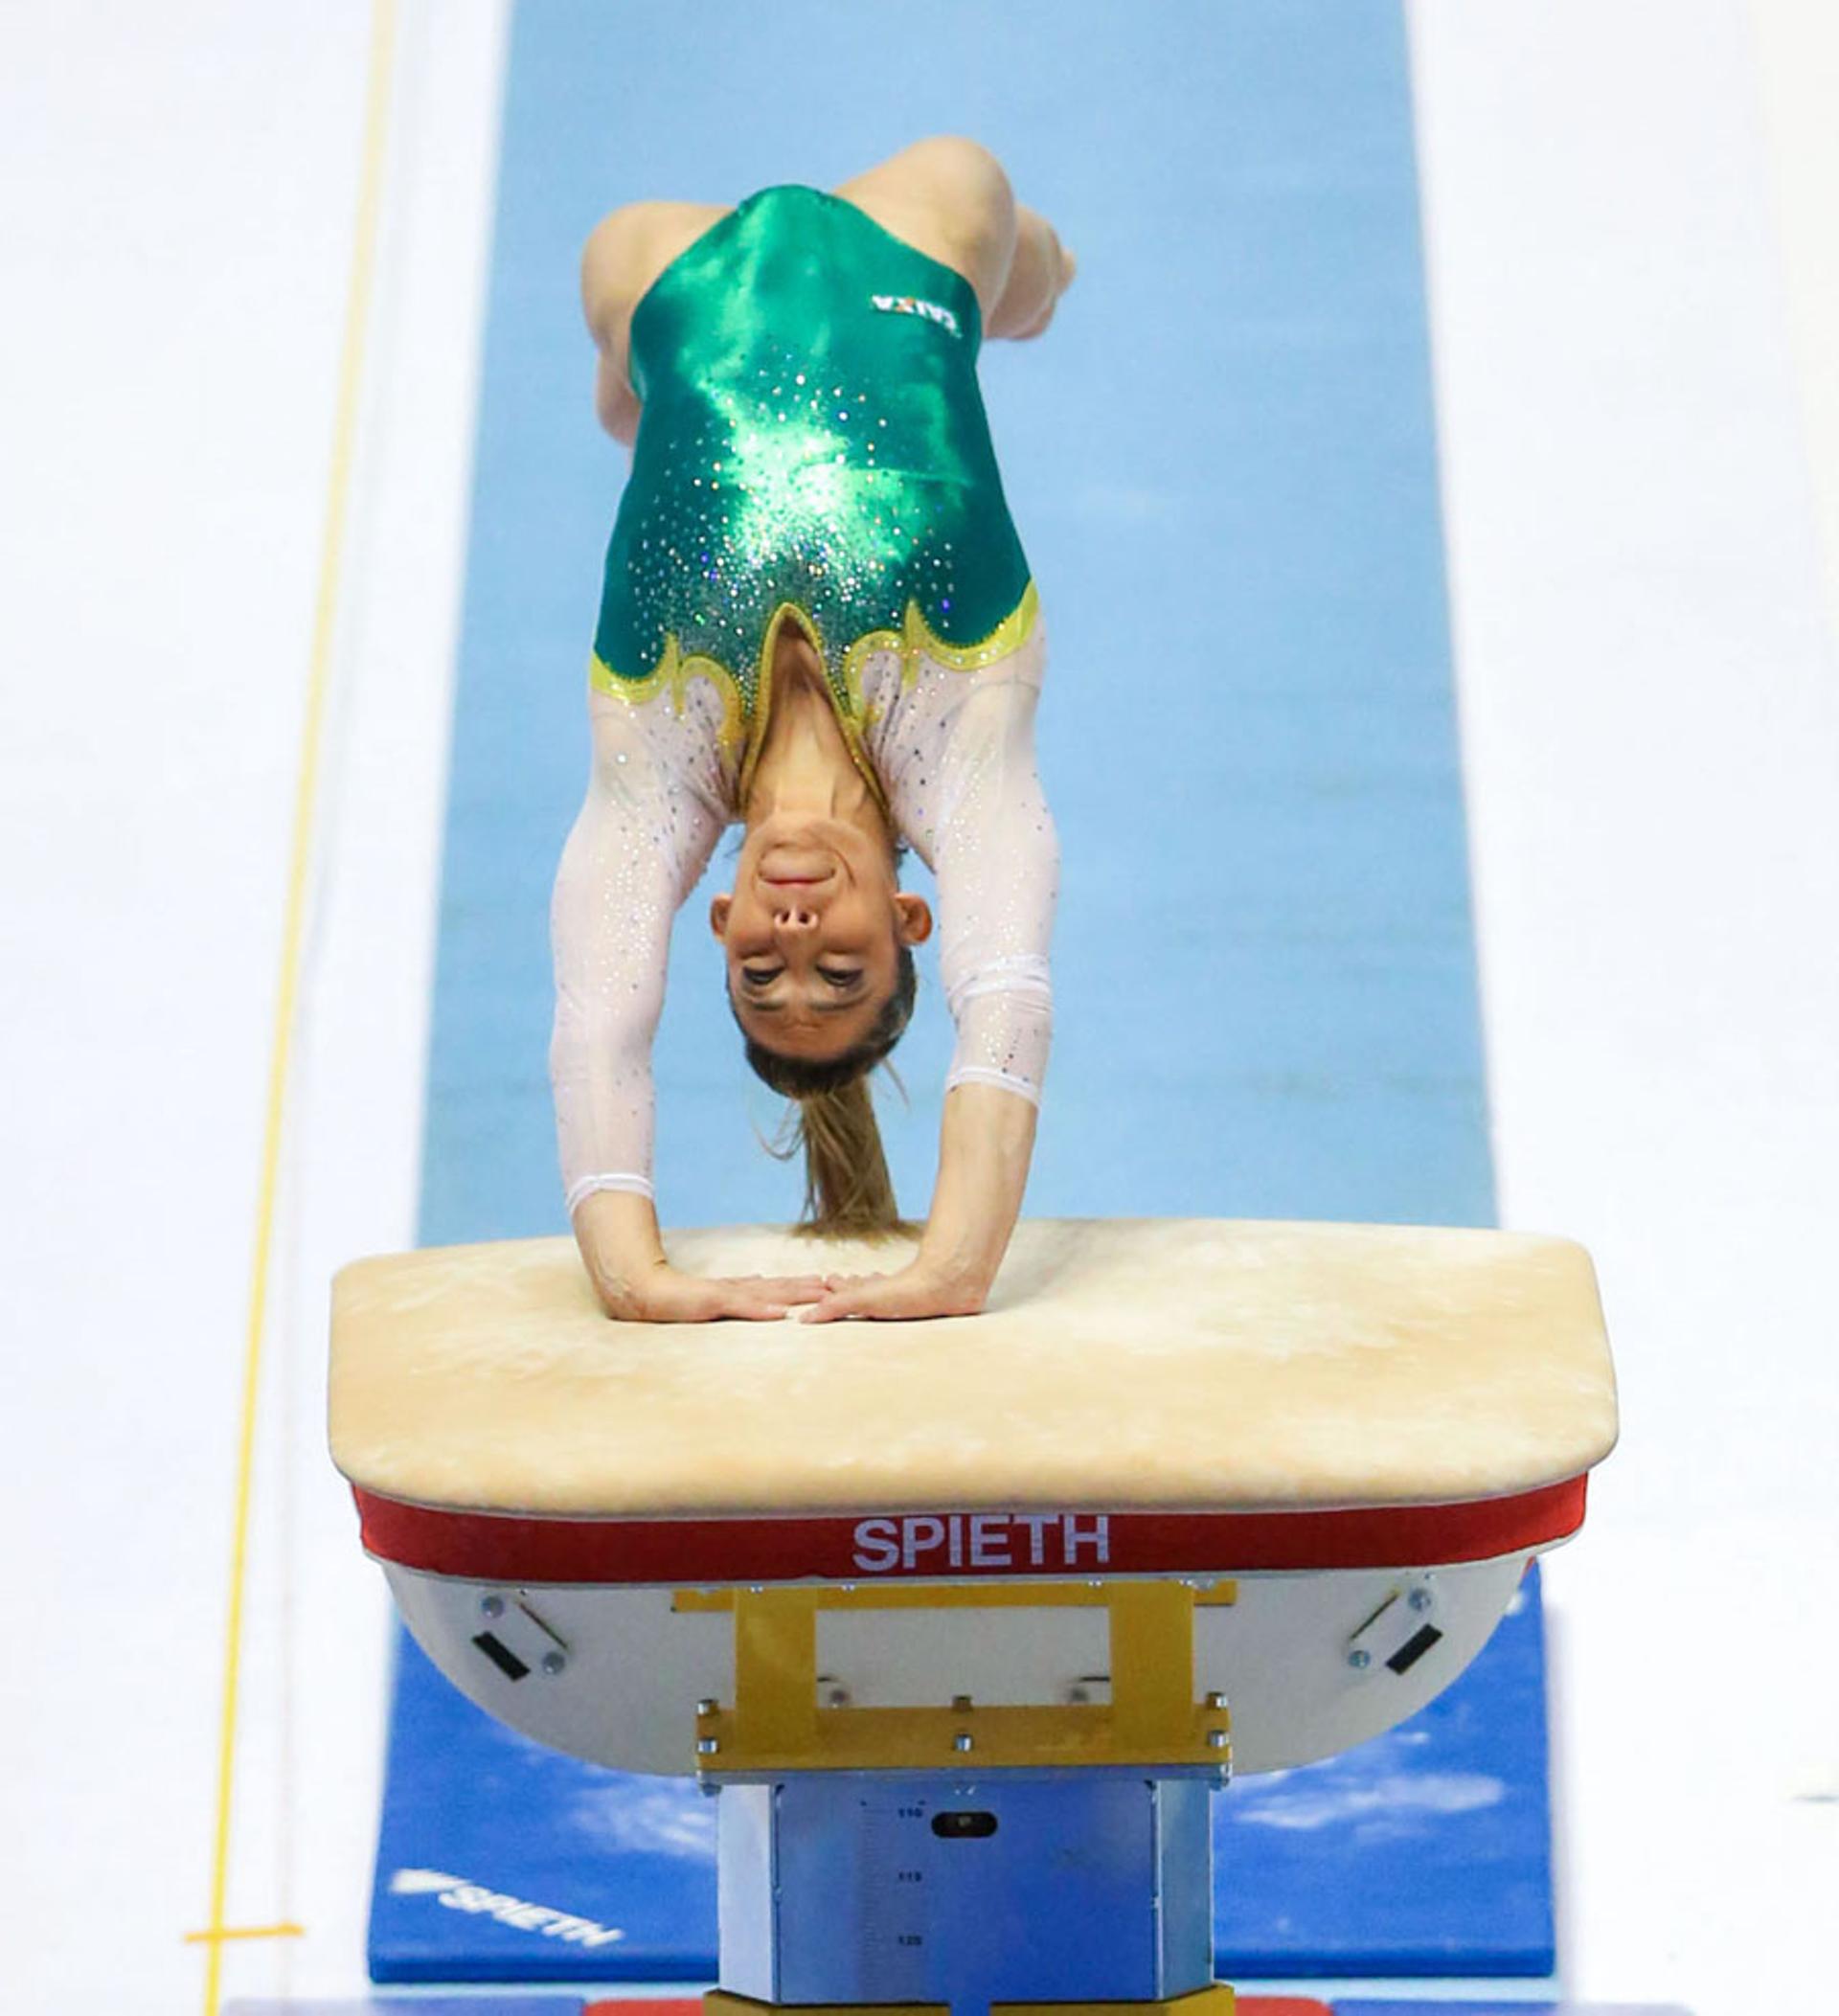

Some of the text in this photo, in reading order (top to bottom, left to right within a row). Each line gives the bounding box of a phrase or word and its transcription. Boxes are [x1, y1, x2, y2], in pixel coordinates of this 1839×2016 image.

[872, 295, 959, 335] CAIXA
[852, 1514, 1110, 1572] SPIETH
[438, 1885, 624, 1947] SPIETH
